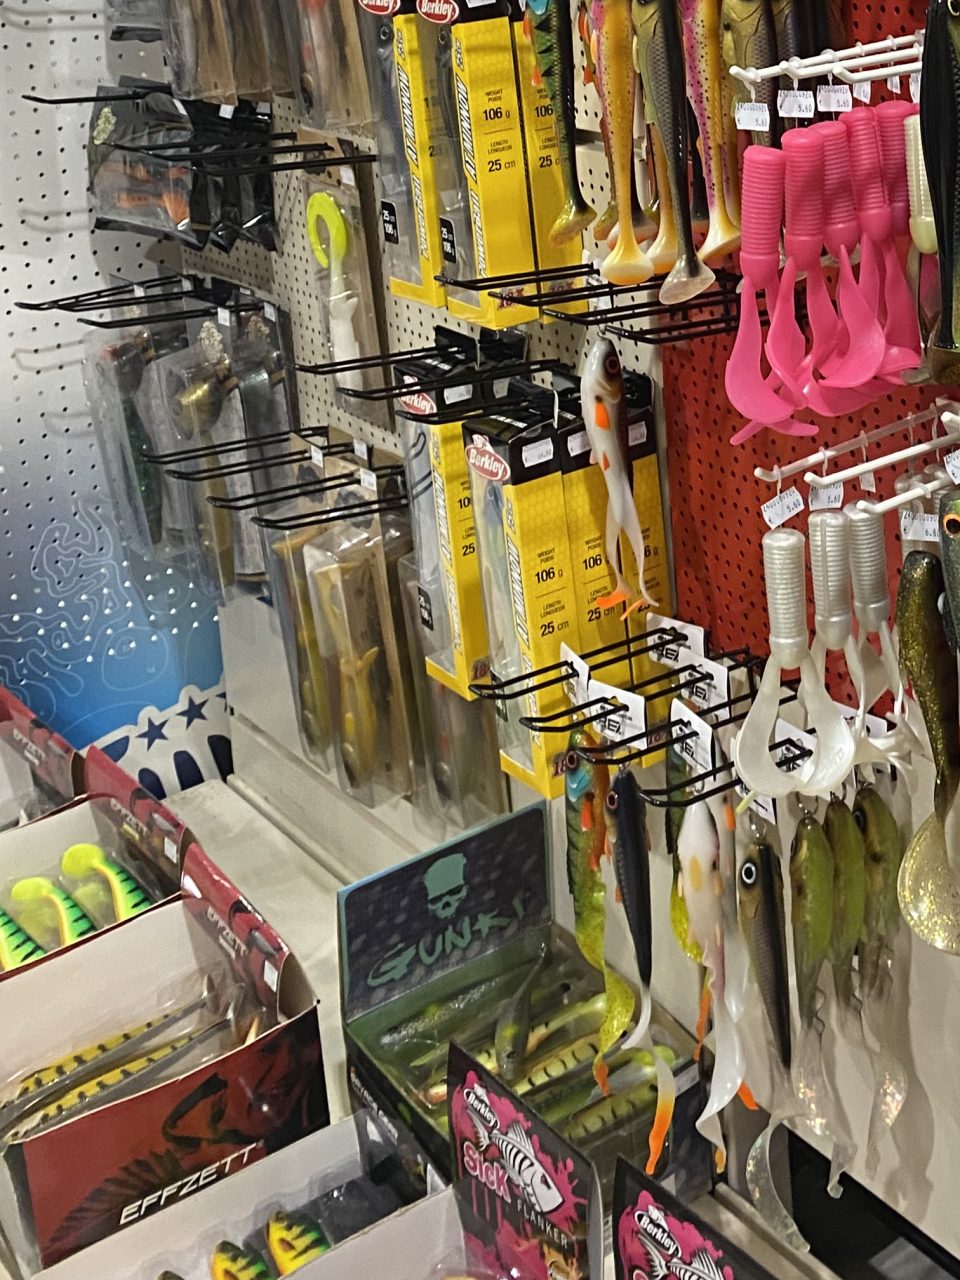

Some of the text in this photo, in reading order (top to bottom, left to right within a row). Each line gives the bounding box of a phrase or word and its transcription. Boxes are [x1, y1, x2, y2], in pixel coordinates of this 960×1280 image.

[421, 0, 453, 22] Berkley
[483, 107, 503, 121] 106
[535, 104, 554, 118] 106
[487, 159, 516, 172] 25 cm
[539, 155, 553, 169] 25
[383, 210, 390, 221] 25
[441, 227, 448, 239] 25
[469, 448, 504, 478] Berkley
[582, 554, 602, 571] 106
[535, 567, 556, 583] 106
[587, 608, 602, 623] 25
[540, 620, 570, 637] 25 cm
[367, 896, 525, 987] GUNKI
[467, 1093, 497, 1126] Berkley
[119, 1142, 257, 1225] EFFZETT
[517, 1200, 569, 1248] FLANKER
[641, 1216, 675, 1255] Berkley
